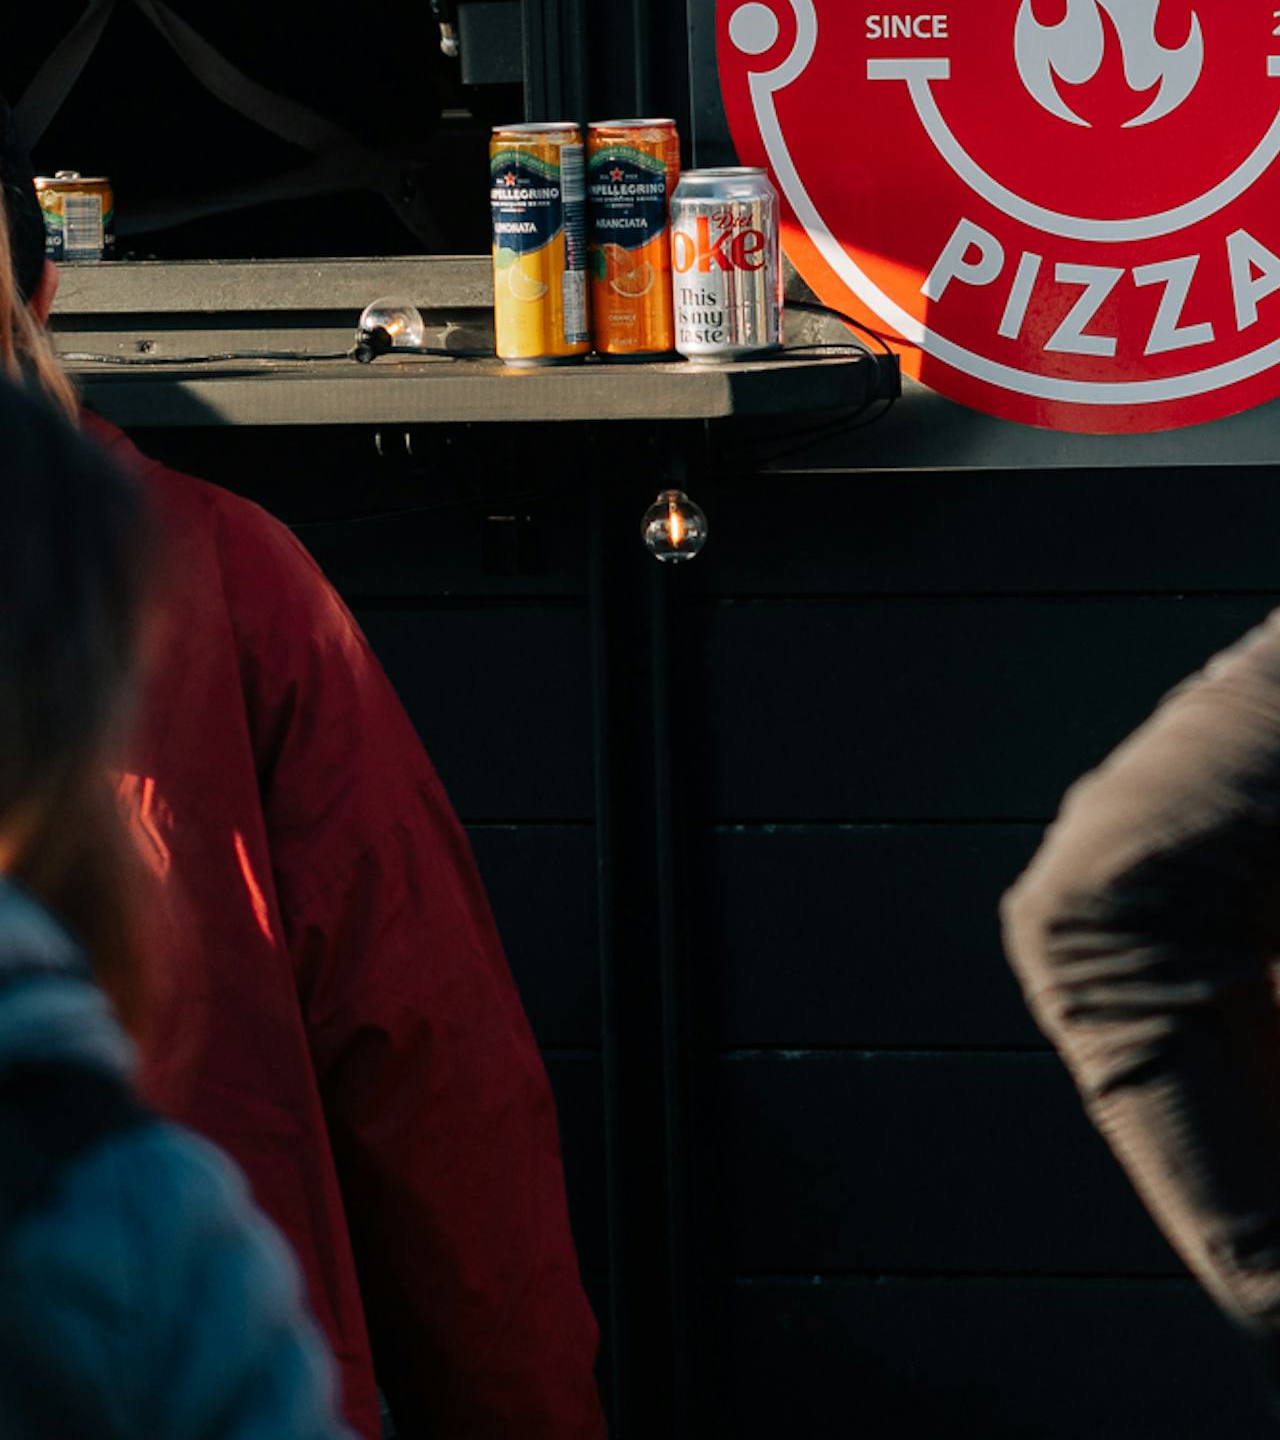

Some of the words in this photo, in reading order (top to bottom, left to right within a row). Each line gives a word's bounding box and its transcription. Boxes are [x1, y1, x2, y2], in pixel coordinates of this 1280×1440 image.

[865, 14, 949, 40] SINCE
[712, 210, 754, 229] Diet
[680, 288, 717, 306] This
[679, 307, 689, 323] is
[692, 309, 723, 327] my
[680, 328, 724, 343] taste
